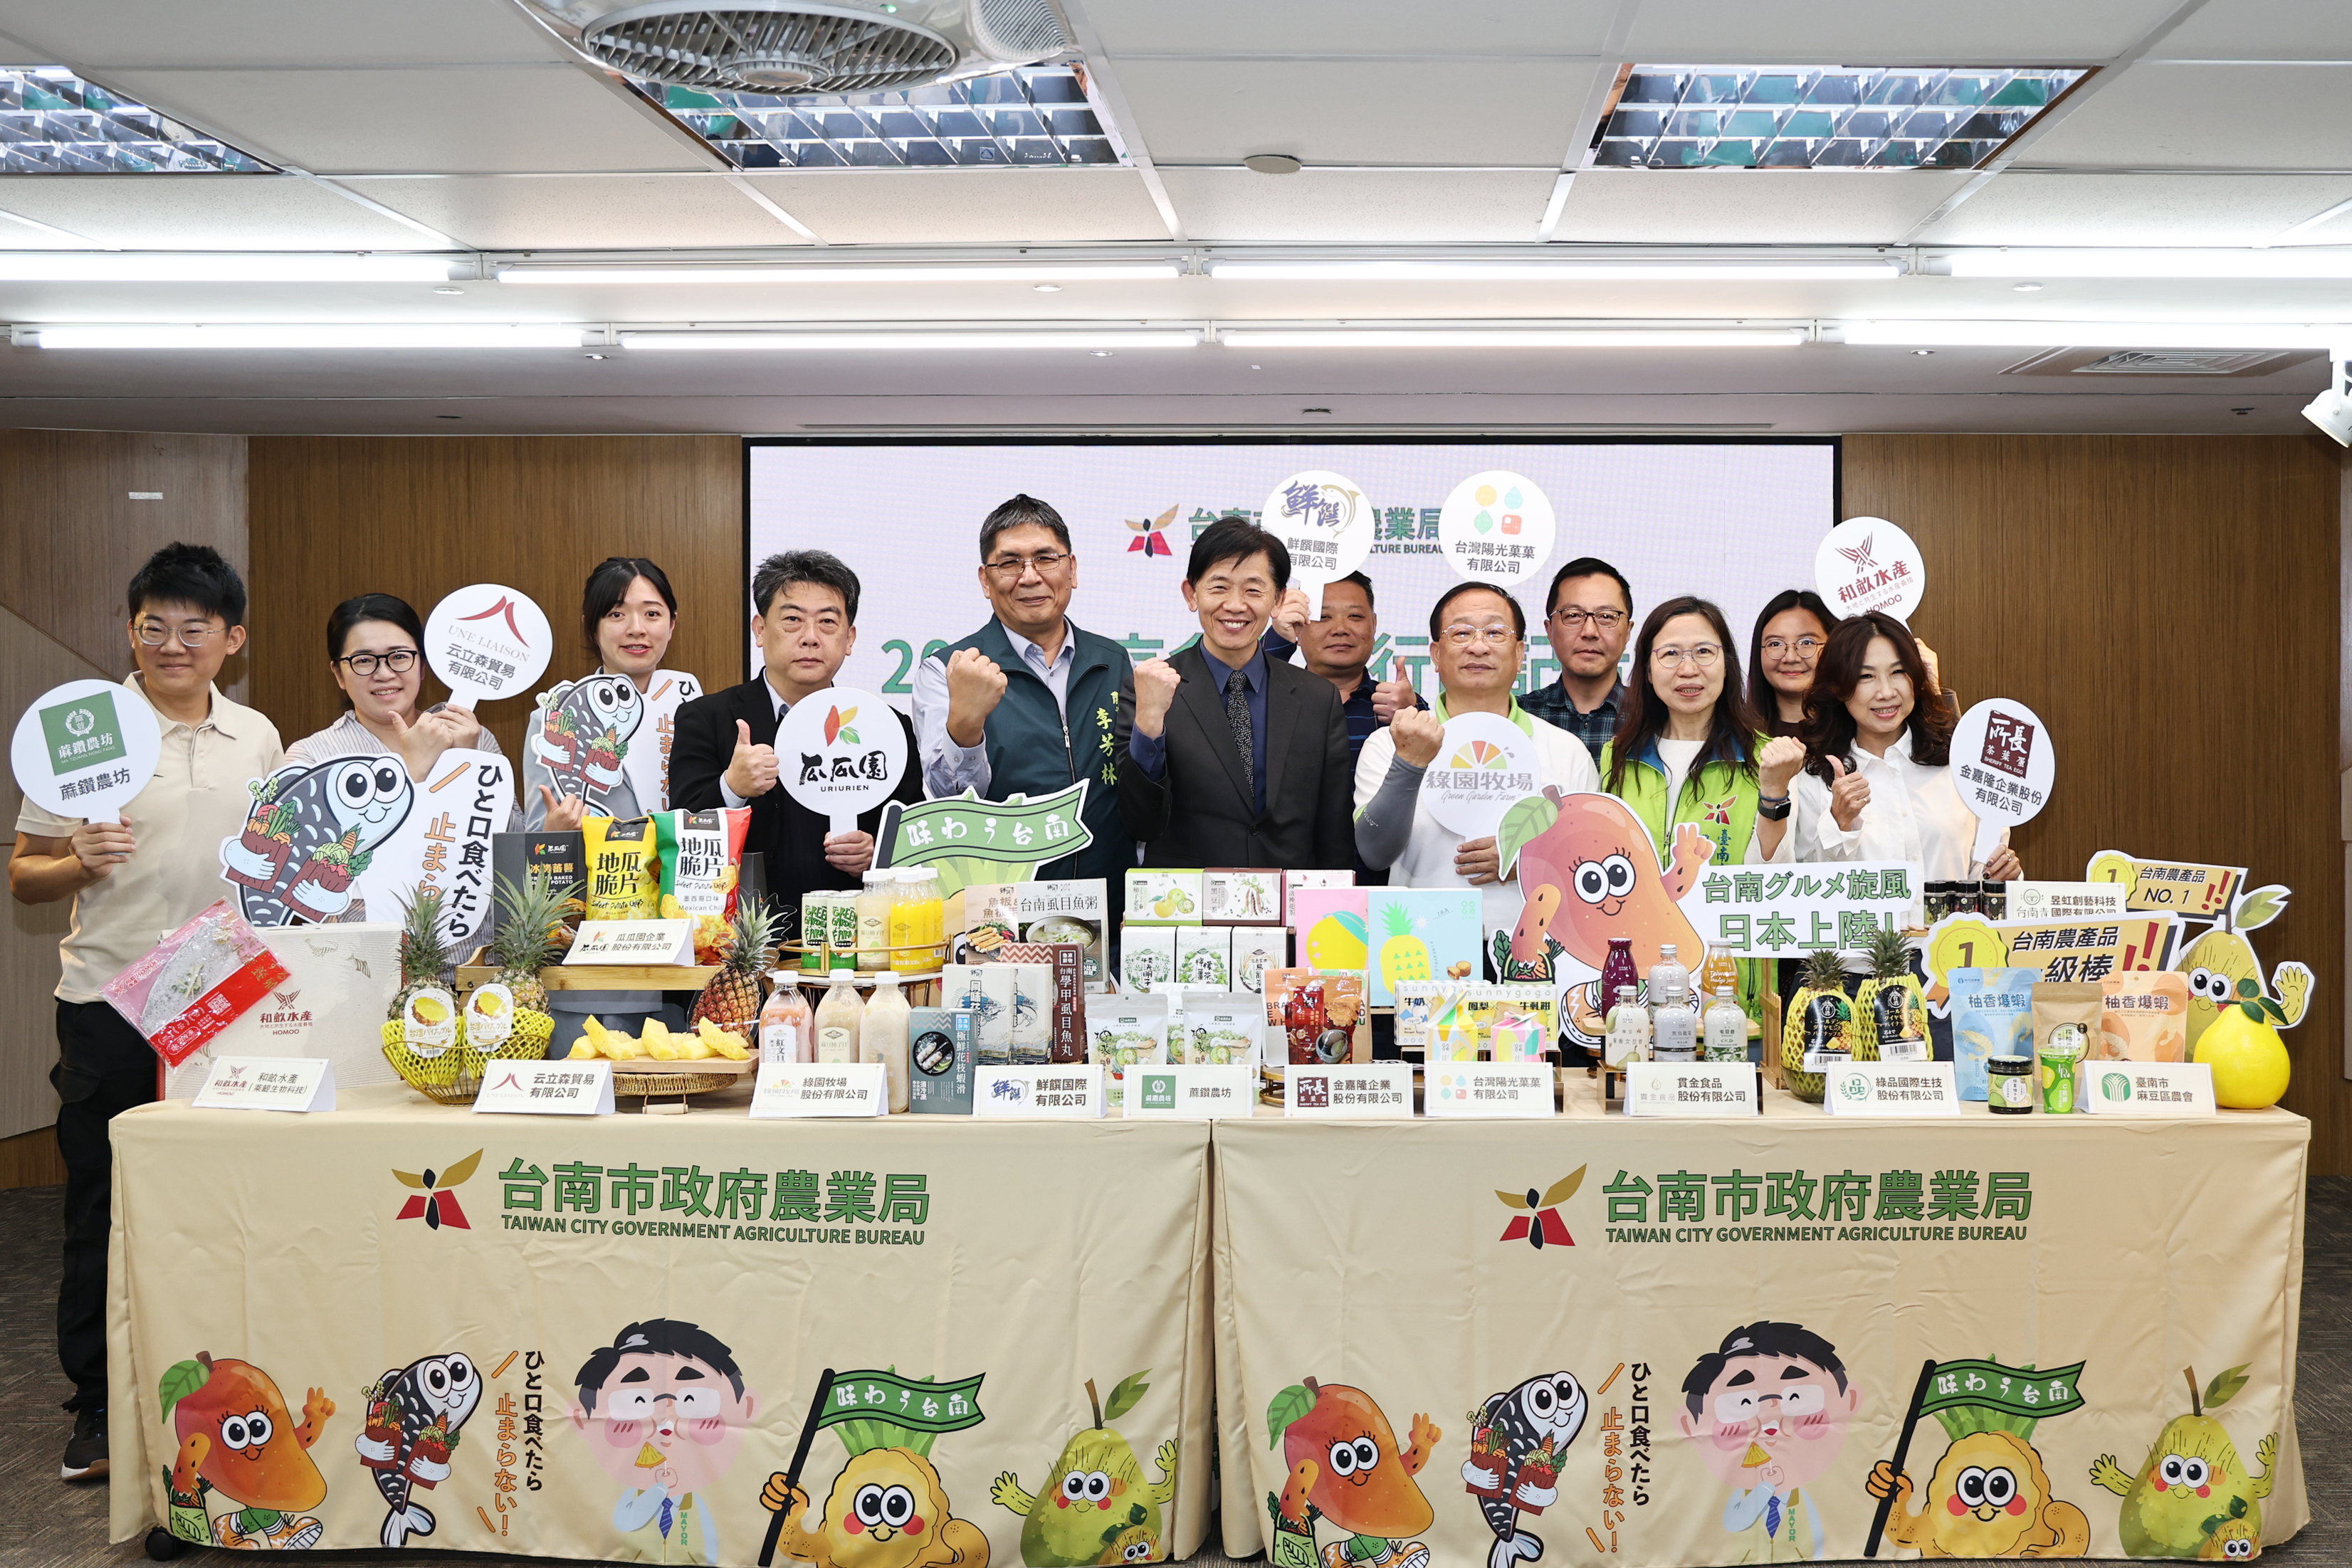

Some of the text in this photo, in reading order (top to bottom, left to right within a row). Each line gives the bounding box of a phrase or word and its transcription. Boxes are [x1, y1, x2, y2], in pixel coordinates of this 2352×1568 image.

[1287, 537, 1338, 555] 鮮饌國際
[1454, 540, 1535, 559] 台灣陽光菓菓
[1288, 552, 1338, 570] 有限公司
[1466, 558, 1521, 575] 有限公司
[1866, 594, 1902, 615] HOMOO
[448, 625, 530, 662] UNE LIAISON
[446, 643, 515, 678] 云立森貿易
[448, 661, 503, 690] 有限公司
[1986, 744, 2026, 768] 茶葉蛋
[1984, 756, 2002, 766] SHERIFF
[2014, 767, 2023, 775] EGG
[1960, 764, 2042, 806] 金嘉隆企業股份
[1442, 790, 1516, 804] Green Garden Farm
[1975, 787, 2022, 816] 有限公司
[906, 813, 1069, 846] 味わう台南
[448, 765, 503, 937] ひと口食べたら
[681, 837, 724, 858] 地瓜
[1716, 829, 1731, 865] 臺南
[597, 851, 641, 873] 地瓜
[680, 856, 724, 877] 脆片
[2139, 866, 2206, 884] 台南農產品
[595, 873, 639, 896] 脆片
[713, 881, 728, 890] Chips
[1702, 869, 1911, 903] 台南グルメ旋風
[592, 898, 644, 910] Sweet Potato Chips
[1021, 895, 1098, 912] 台南虱目魚粥
[2051, 895, 2116, 907] 昱虹創藝科技
[2144, 888, 2191, 904] NO. 1
[616, 932, 666, 942] 瓜瓜園企業
[2012, 927, 2119, 952] 台南農產品
[1429, 941, 1439, 972] PINEAPPLE
[1467, 989, 1550, 998] sunnygogo
[1968, 994, 2027, 1008] 柚香爆蝦
[2106, 995, 2169, 1010] 柚香爆蝦
[1469, 1001, 1489, 1010] 鳳梨
[1519, 1001, 1550, 1010] 牛軋餅
[1060, 975, 1073, 1056] 學甲虱目魚丸
[956, 1031, 966, 1094] 極鮮花枝蝦滑
[533, 1073, 595, 1085] 云立森貿易
[1333, 1080, 1391, 1090] 金嘉隆企業
[1474, 1076, 1541, 1088] 台灣陽光菓菓
[1677, 1078, 1722, 1088] 貫金食品
[1876, 1076, 1943, 1088] 綠品國際生技
[2136, 1077, 2169, 1089] 臺南市
[529, 1087, 579, 1098] 有限公司
[800, 1090, 868, 1100] 股份有限公司
[1035, 1094, 1086, 1106] 有限公司
[1189, 1088, 1232, 1098] 蔴鑽農坊
[1333, 1093, 1402, 1104] 股份有限公司
[1474, 1089, 1518, 1100] 有限公司
[1678, 1091, 1745, 1102] 股份有限公司
[1877, 1090, 1943, 1100] 股份有限公司
[2137, 1090, 2193, 1103] 麻豆區農會
[498, 1157, 930, 1225] 台南市政府農業局
[1603, 1169, 2032, 1223] 台南市政府農業局
[502, 1214, 925, 1246] TAIWAN CITY GOVERNMENT AGRICULTURE BUREAU
[1605, 1226, 2027, 1243] TAIWAN CITY GOVERNMENT AGRICULTURE BUREAU
[1938, 1372, 2069, 1404] 味わう台南
[836, 1384, 969, 1418] 味わう台南
[523, 1350, 545, 1492] ひと口食べたら
[1630, 1362, 1652, 1507] ひと口食べたら
[680, 1511, 688, 1547] MAYOR
[1787, 1508, 1796, 1542] MAYOR
